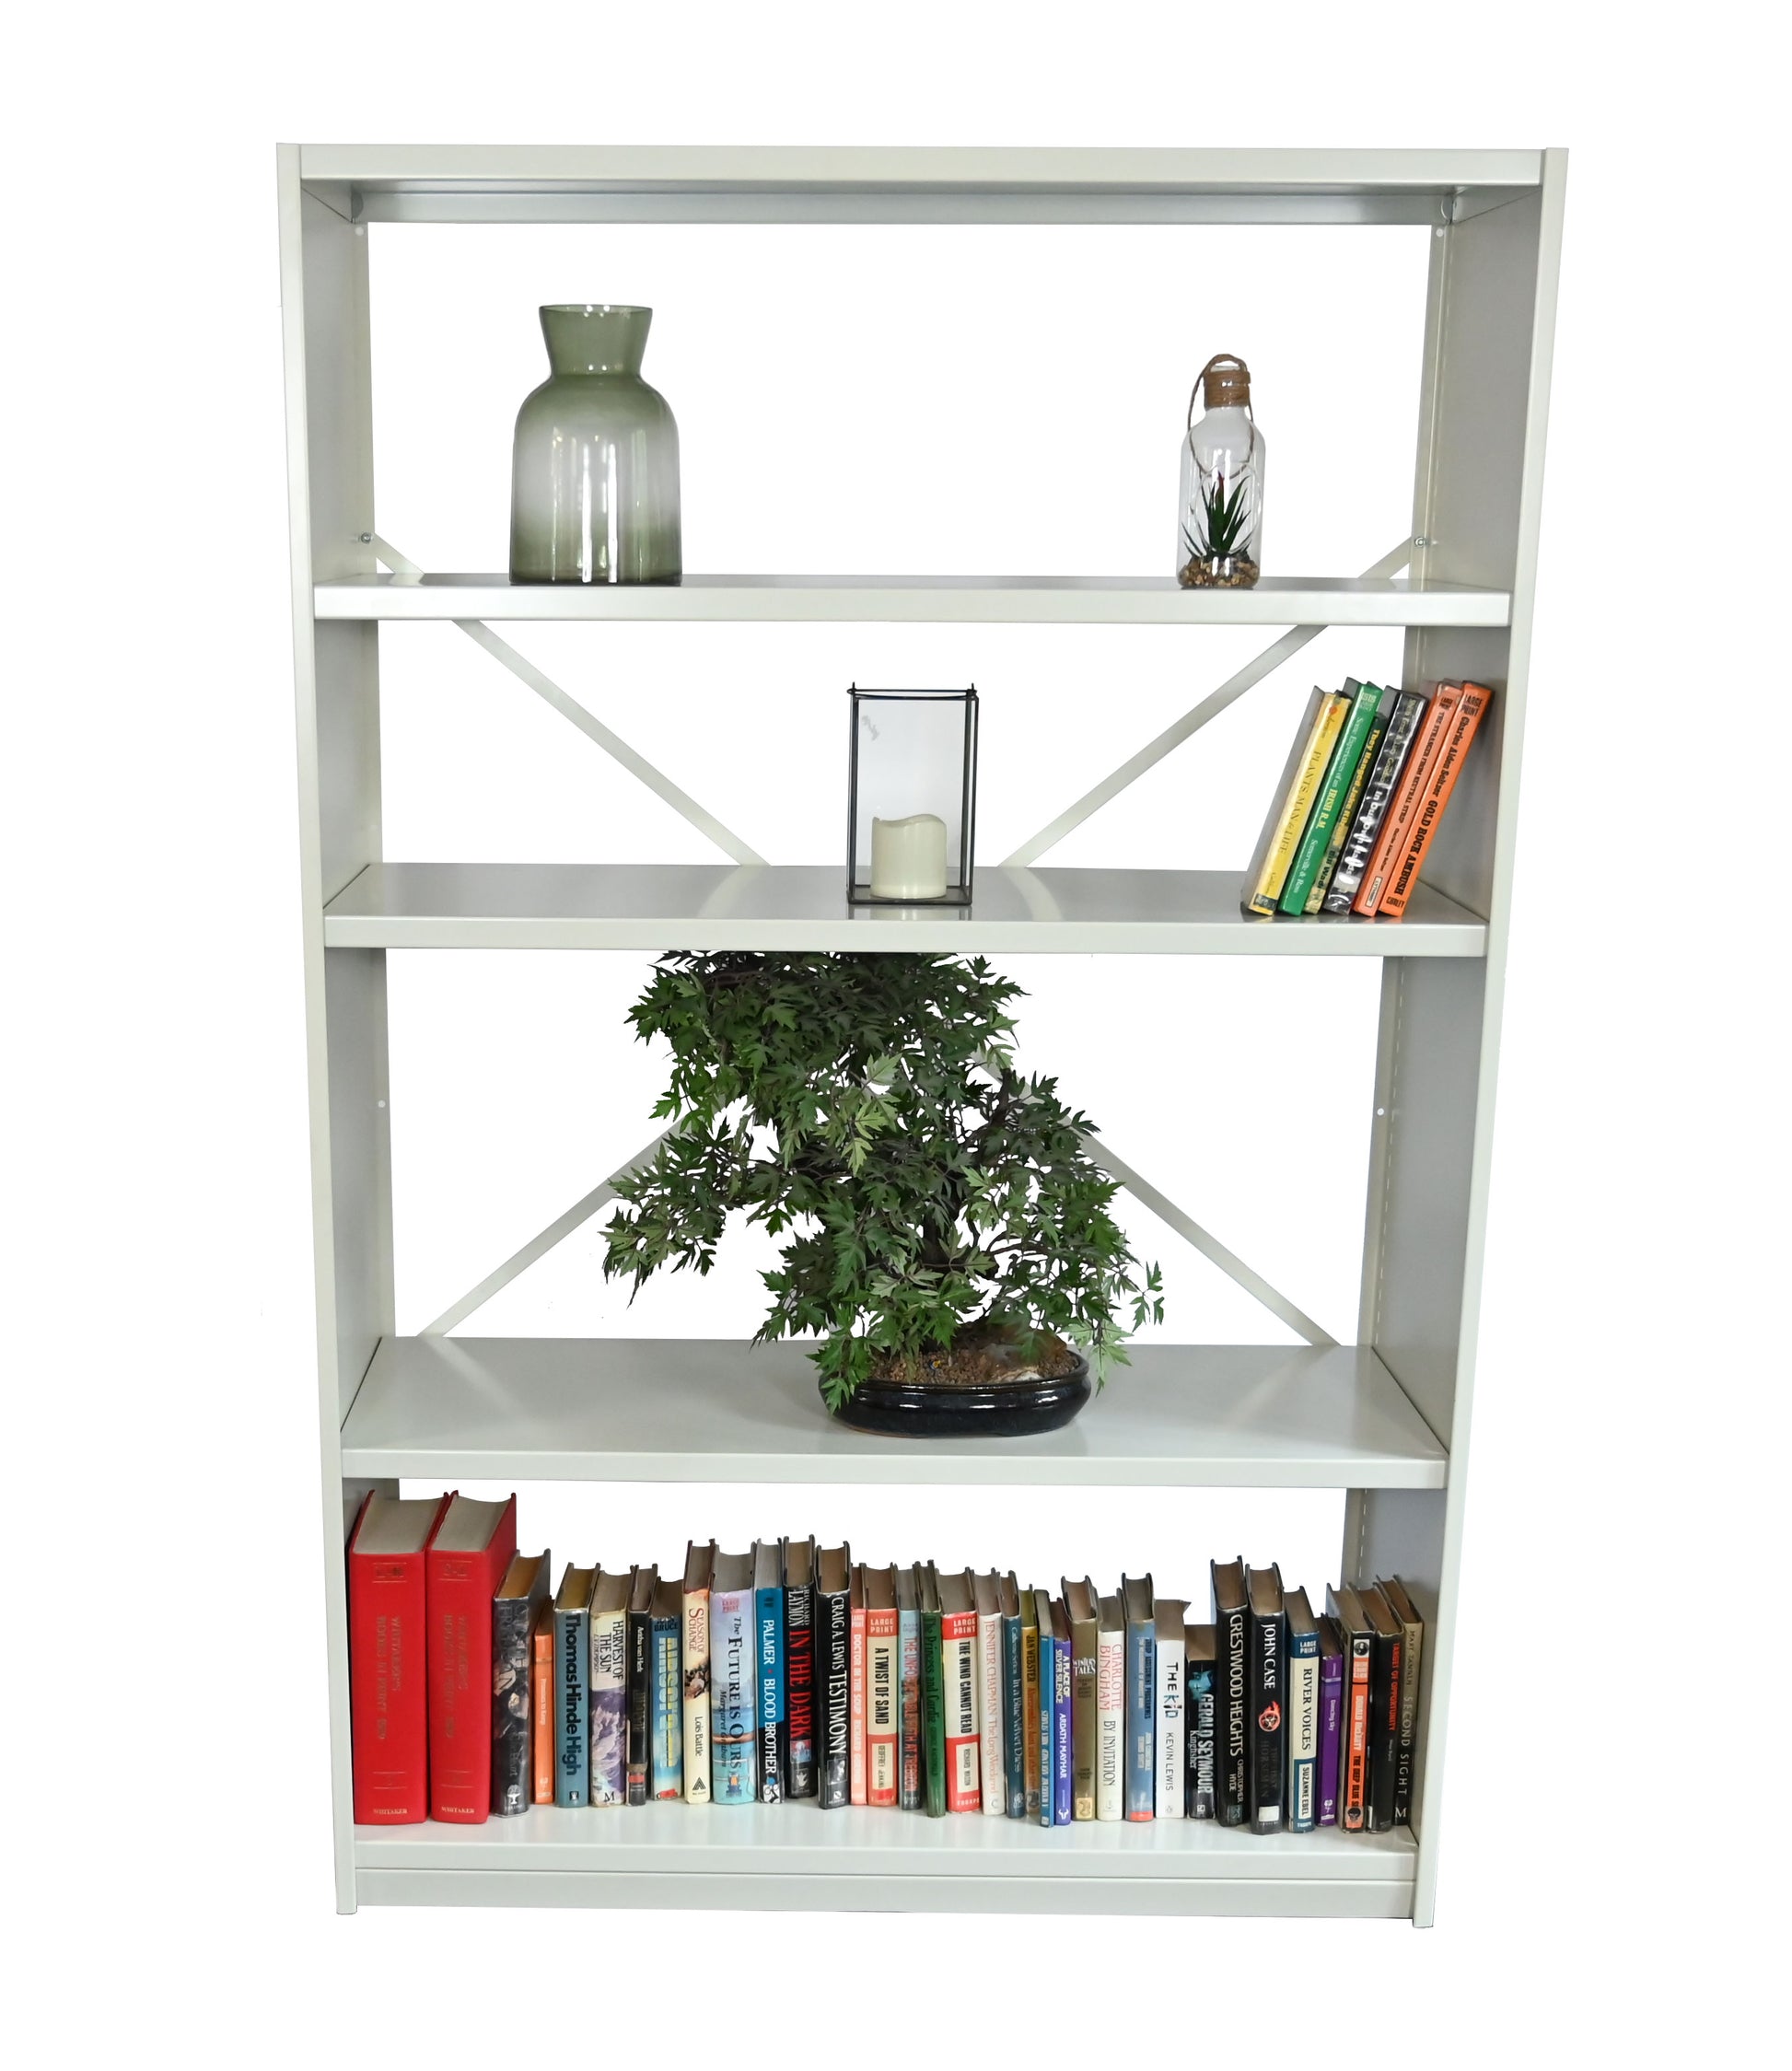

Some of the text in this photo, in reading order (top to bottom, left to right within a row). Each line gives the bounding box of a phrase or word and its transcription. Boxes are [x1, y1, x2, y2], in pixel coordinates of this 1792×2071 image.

[1365, 727, 1380, 751] They
[1422, 724, 1439, 758] STRANGER
[1352, 750, 1373, 787] Hanged
[1414, 756, 1427, 776] FROM
[1314, 787, 1338, 831] IRISH R.M.
[1344, 785, 1360, 810] Jake
[1373, 789, 1383, 800] In
[1392, 715, 1470, 896] Charles Alden Seltzer GOLD ROCK AMBUSH
[1396, 804, 1409, 824] STRIP
[788, 1590, 804, 1627] LAYMON
[832, 1597, 845, 1628] CRAIG
[953, 1618, 976, 1626] LARGE
[689, 1618, 698, 1651] CHANGE
[763, 1619, 775, 1666] PALMER
[903, 1636, 920, 1654] THE
[953, 1625, 976, 1635] PRINT
[1026, 1635, 1036, 1648] JAN
[599, 1634, 612, 1673] THE SUN
[612, 1621, 624, 1681] HARVEST OF
[832, 1642, 845, 1670] LEWIS
[875, 1656, 890, 1683] TWIST
[925, 1614, 939, 1723] The Princess and Curdie
[1026, 1648, 1037, 1683] WEBSTER
[1262, 1623, 1276, 1691] JOHN CASE
[562, 1614, 582, 1775] Thomas Hinde High
[728, 1616, 744, 1769] The FUTURE IS OURS
[789, 1629, 812, 1740] IN THE DARK
[853, 1635, 864, 1751] DOCTOR IN THE SOUP RICHARD
[875, 1686, 889, 1697] OF
[959, 1641, 973, 1734] THE WIND CANNOT READ
[1012, 1678, 1021, 1688] In
[1055, 1649, 1064, 1704] SILVER SILENCE
[1063, 1686, 1070, 1697] OF
[1100, 1646, 1111, 1711] BINGHAM
[1111, 1644, 1123, 1711] CHARLOTTE
[1167, 1661, 1180, 1692] THE
[1229, 1613, 1244, 1757] CRESTWOOD HEIGHTS
[1388, 1643, 1401, 1730] TARGET OF OPPORTUNITY
[718, 1689, 728, 1731] Margaret
[763, 1678, 776, 1718] BLOOD
[828, 1670, 848, 1754] TESTIMONY
[875, 1699, 890, 1725] SAND
[984, 1620, 999, 1793] JENNIFER CHAPMAN The Long Weekend
[1013, 1698, 1023, 1715] Blue
[1301, 1668, 1314, 1751] RIVER VOICES
[1327, 1699, 1337, 1731] Dancing Sky
[695, 1716, 704, 1757] Lois Battle
[1013, 1716, 1023, 1746] Velvet
[1402, 1696, 1414, 1747] SECOND
[764, 1721, 776, 1774] BROTHER
[878, 1745, 886, 1767] GEOFFREY
[904, 1743, 919, 1754] AT
[963, 1748, 972, 1768] RICHARD
[1060, 1713, 1068, 1778] ARDATH MAYHAR
[1103, 1720, 1116, 1786] BY INVITATION
[1166, 1732, 1174, 1791] KEVIN LEWIS
[1188, 1729, 1199, 1769] Kingfisher
[1197, 1693, 1215, 1794] GERALD SEYMOUR
[1354, 1755, 1362, 1766] THE
[1228, 1773, 1238, 1793] HYDE
[1300, 1766, 1311, 1816] SUZANNE EBEL
[1353, 1768, 1361, 1783] DEEP
[1398, 1753, 1410, 1795] SIGHT
[441, 1807, 475, 1815] WHITAKER
[1352, 1785, 1360, 1801] BLUE
[1394, 1807, 1407, 1818] M
